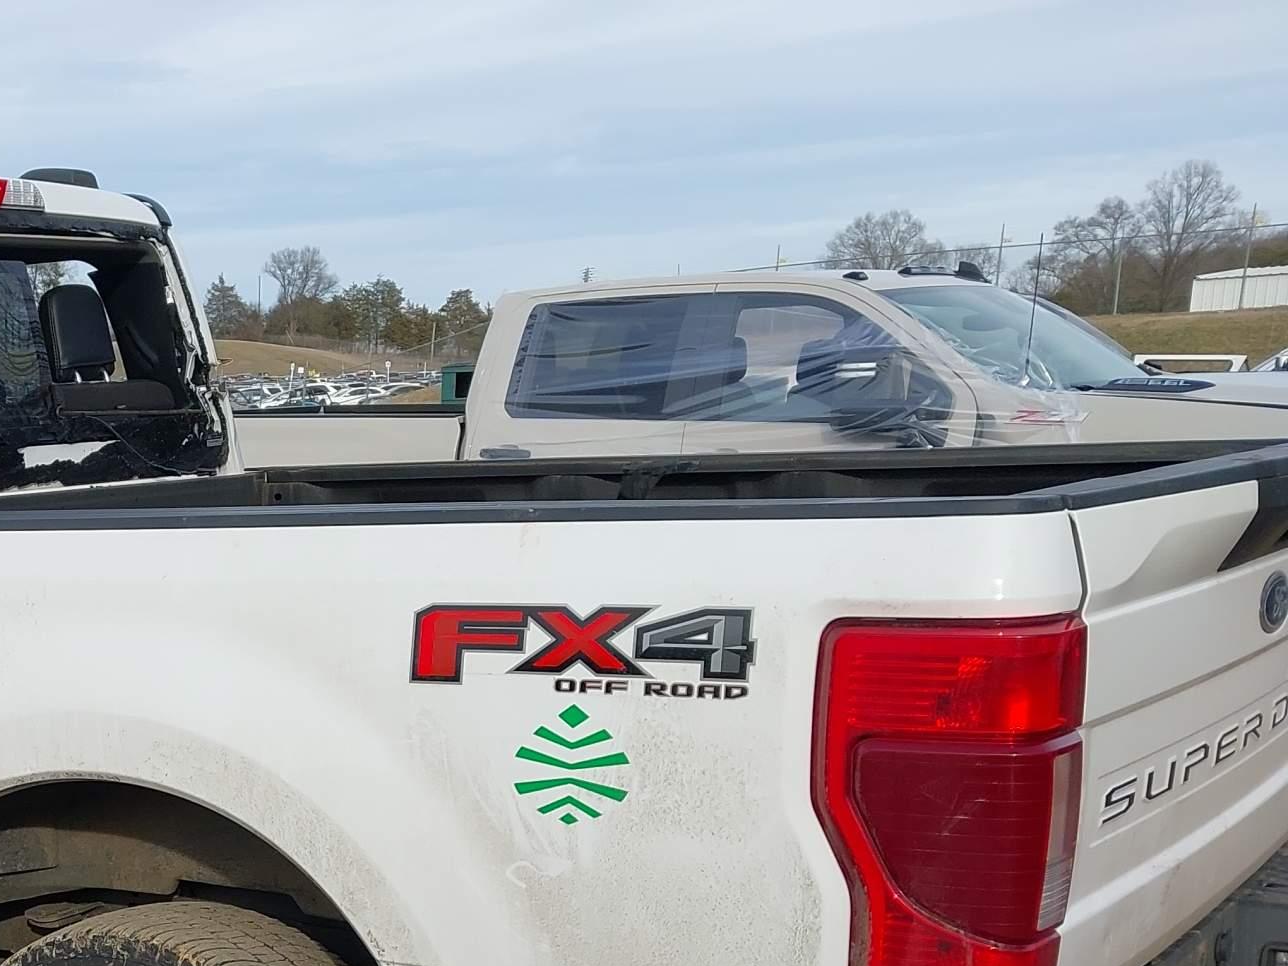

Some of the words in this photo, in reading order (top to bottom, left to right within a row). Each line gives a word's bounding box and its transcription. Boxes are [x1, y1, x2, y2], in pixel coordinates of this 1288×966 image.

[409, 602, 758, 685] FX4
[554, 677, 629, 696] OFF
[643, 680, 749, 700] ROAD
[1101, 712, 1263, 825] SUPER
